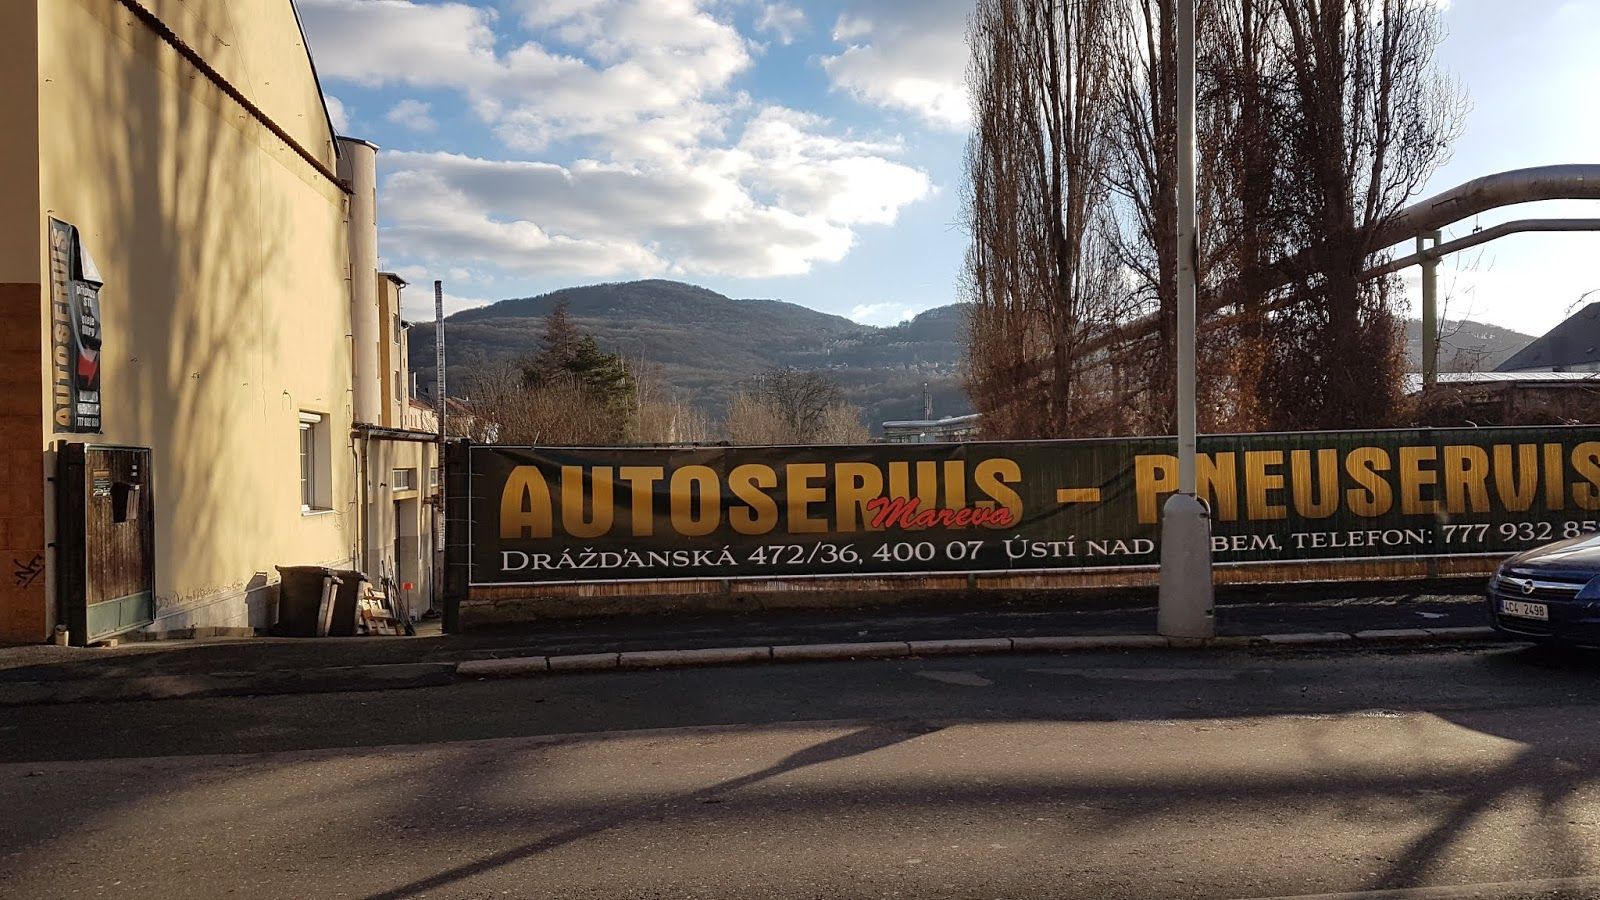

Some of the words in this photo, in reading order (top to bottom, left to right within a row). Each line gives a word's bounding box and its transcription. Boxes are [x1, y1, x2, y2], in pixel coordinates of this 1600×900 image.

[52, 229, 71, 427] AUTOSERVIS
[500, 458, 1024, 539] AUTOSERVIS
[1135, 441, 1600, 524] PNEUSERVIS
[866, 496, 1014, 530] Mareva
[747, 540, 864, 565] 472/36,
[872, 542, 936, 562] 400
[945, 540, 984, 560] 07
[1086, 538, 1155, 557] NAD
[1211, 533, 1283, 552] BEM,
[1291, 527, 1433, 550] TELEFON:
[1442, 523, 1491, 544] 777
[1499, 521, 1553, 542] 932
[1563, 520, 1600, 539] 85
